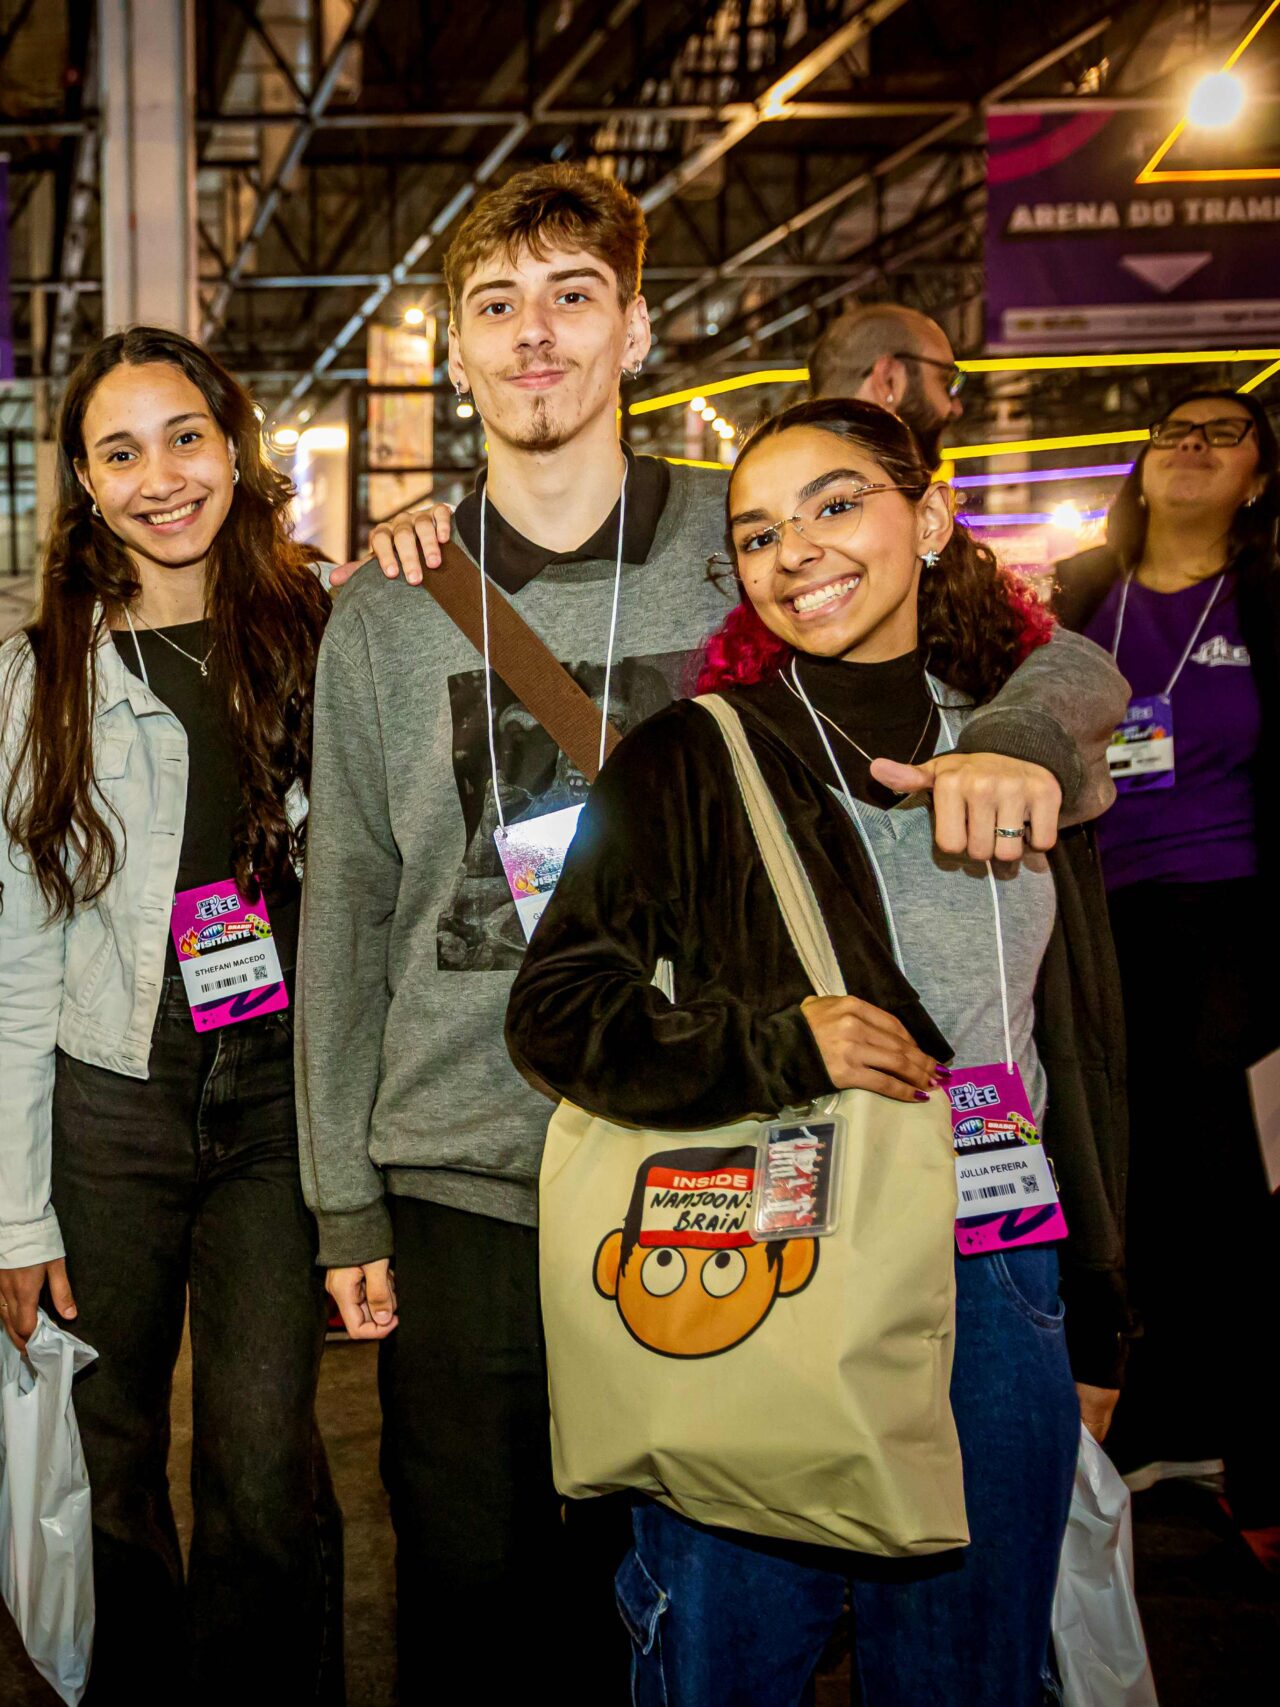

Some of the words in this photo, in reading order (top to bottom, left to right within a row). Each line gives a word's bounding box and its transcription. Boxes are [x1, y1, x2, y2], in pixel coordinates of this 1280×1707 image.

[1006, 201, 1120, 233] ARENA
[1127, 199, 1175, 229] DO
[194, 929, 251, 950] VISITANTE
[195, 963, 232, 977] STHEFANI
[233, 953, 266, 968] MACEDO
[990, 1161, 1028, 1175] PEREIRA
[672, 1173, 749, 1189] INSIDE
